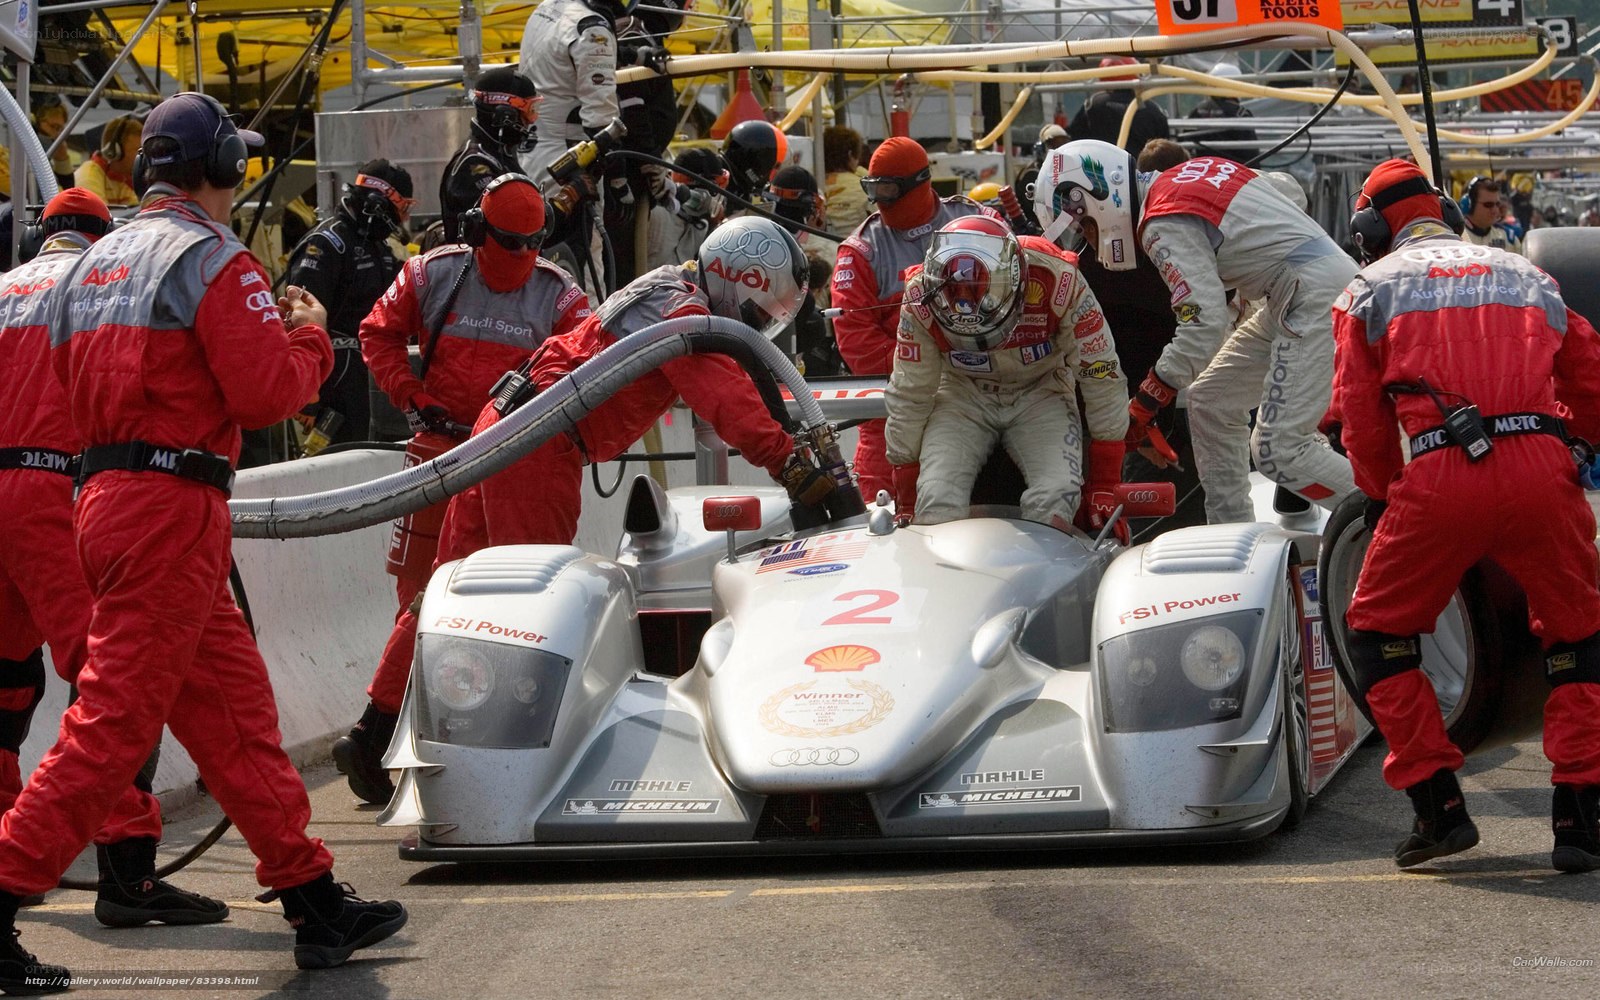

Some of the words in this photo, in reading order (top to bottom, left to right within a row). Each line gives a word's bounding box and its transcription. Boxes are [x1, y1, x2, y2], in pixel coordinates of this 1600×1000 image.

[1260, 7, 1320, 19] TOOLS
[1353, 0, 1460, 11] RACNG
[1441, 36, 1528, 48] RACING
[1542, 18, 1571, 50] 8
[1204, 162, 1239, 190] Audi
[80, 265, 131, 287] Audi
[705, 256, 771, 293] Audi
[1428, 263, 1494, 279] Audi
[0, 278, 56, 298] Aud
[1055, 272, 1072, 306] sparco
[1410, 287, 1449, 300] Audi
[1455, 285, 1518, 296] Service
[556, 288, 580, 311] sparco
[459, 315, 493, 329] Audi
[495, 320, 534, 337] Sport
[1082, 361, 1117, 377] SUNOCO
[1262, 342, 1291, 424] Sport
[1494, 415, 1542, 433] MRTC
[1411, 429, 1447, 454] MRTC
[820, 589, 900, 626] 2
[1118, 605, 1159, 625] FSI
[1163, 592, 1242, 613] Power
[434, 616, 473, 630] FSI
[475, 621, 548, 643] Power
[794, 692, 865, 700] Winner
[610, 780, 691, 792] MAHLE
[963, 769, 1044, 784] MAHLE
[960, 789, 1073, 802] MICHELIN
[602, 802, 712, 810] MICHELIN
